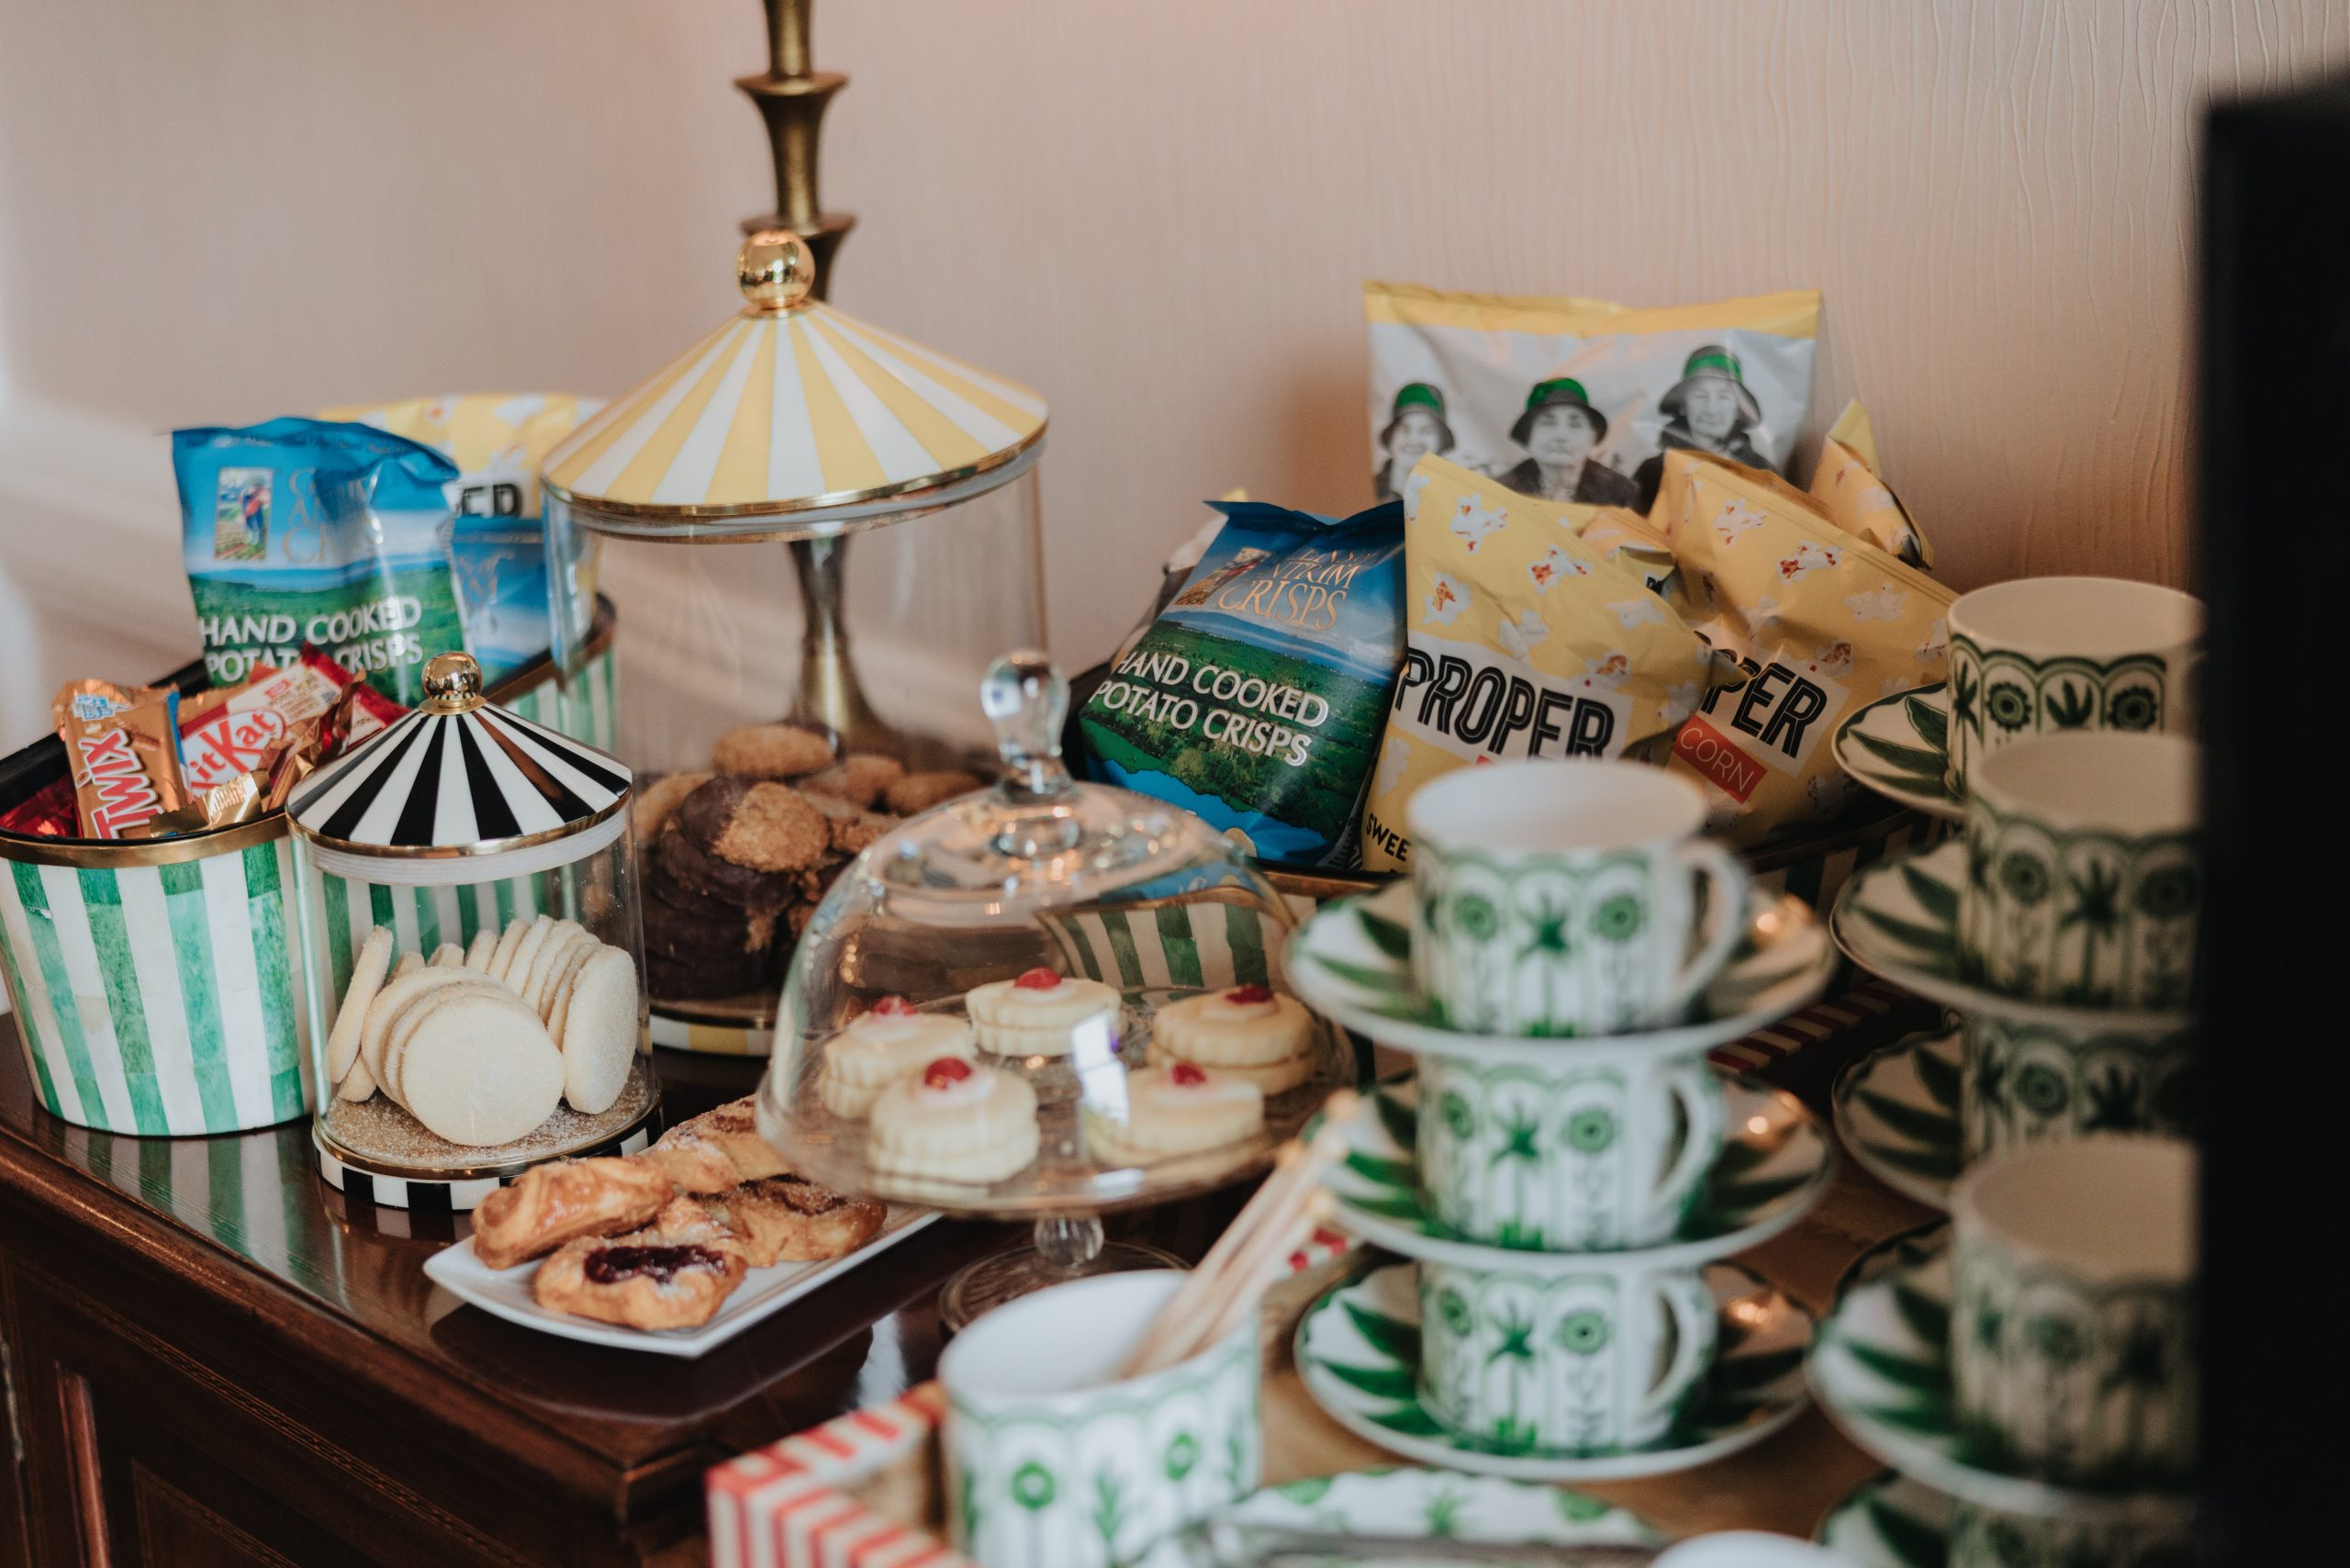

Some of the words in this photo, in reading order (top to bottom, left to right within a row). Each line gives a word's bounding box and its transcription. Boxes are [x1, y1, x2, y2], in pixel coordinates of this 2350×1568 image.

[197, 614, 297, 645] HAND
[304, 597, 423, 645] COOKED
[1218, 578, 1348, 631] CRISPS
[204, 645, 301, 683] POTAT
[333, 633, 424, 675] CRISPS
[1087, 679, 1199, 731] POTATO
[1203, 708, 1313, 767] CRISPS
[1192, 665, 1330, 728] COOKED
[1393, 646, 1616, 763] PROPER
[1679, 726, 1755, 793] CORN
[1365, 812, 1413, 863] SWEE
